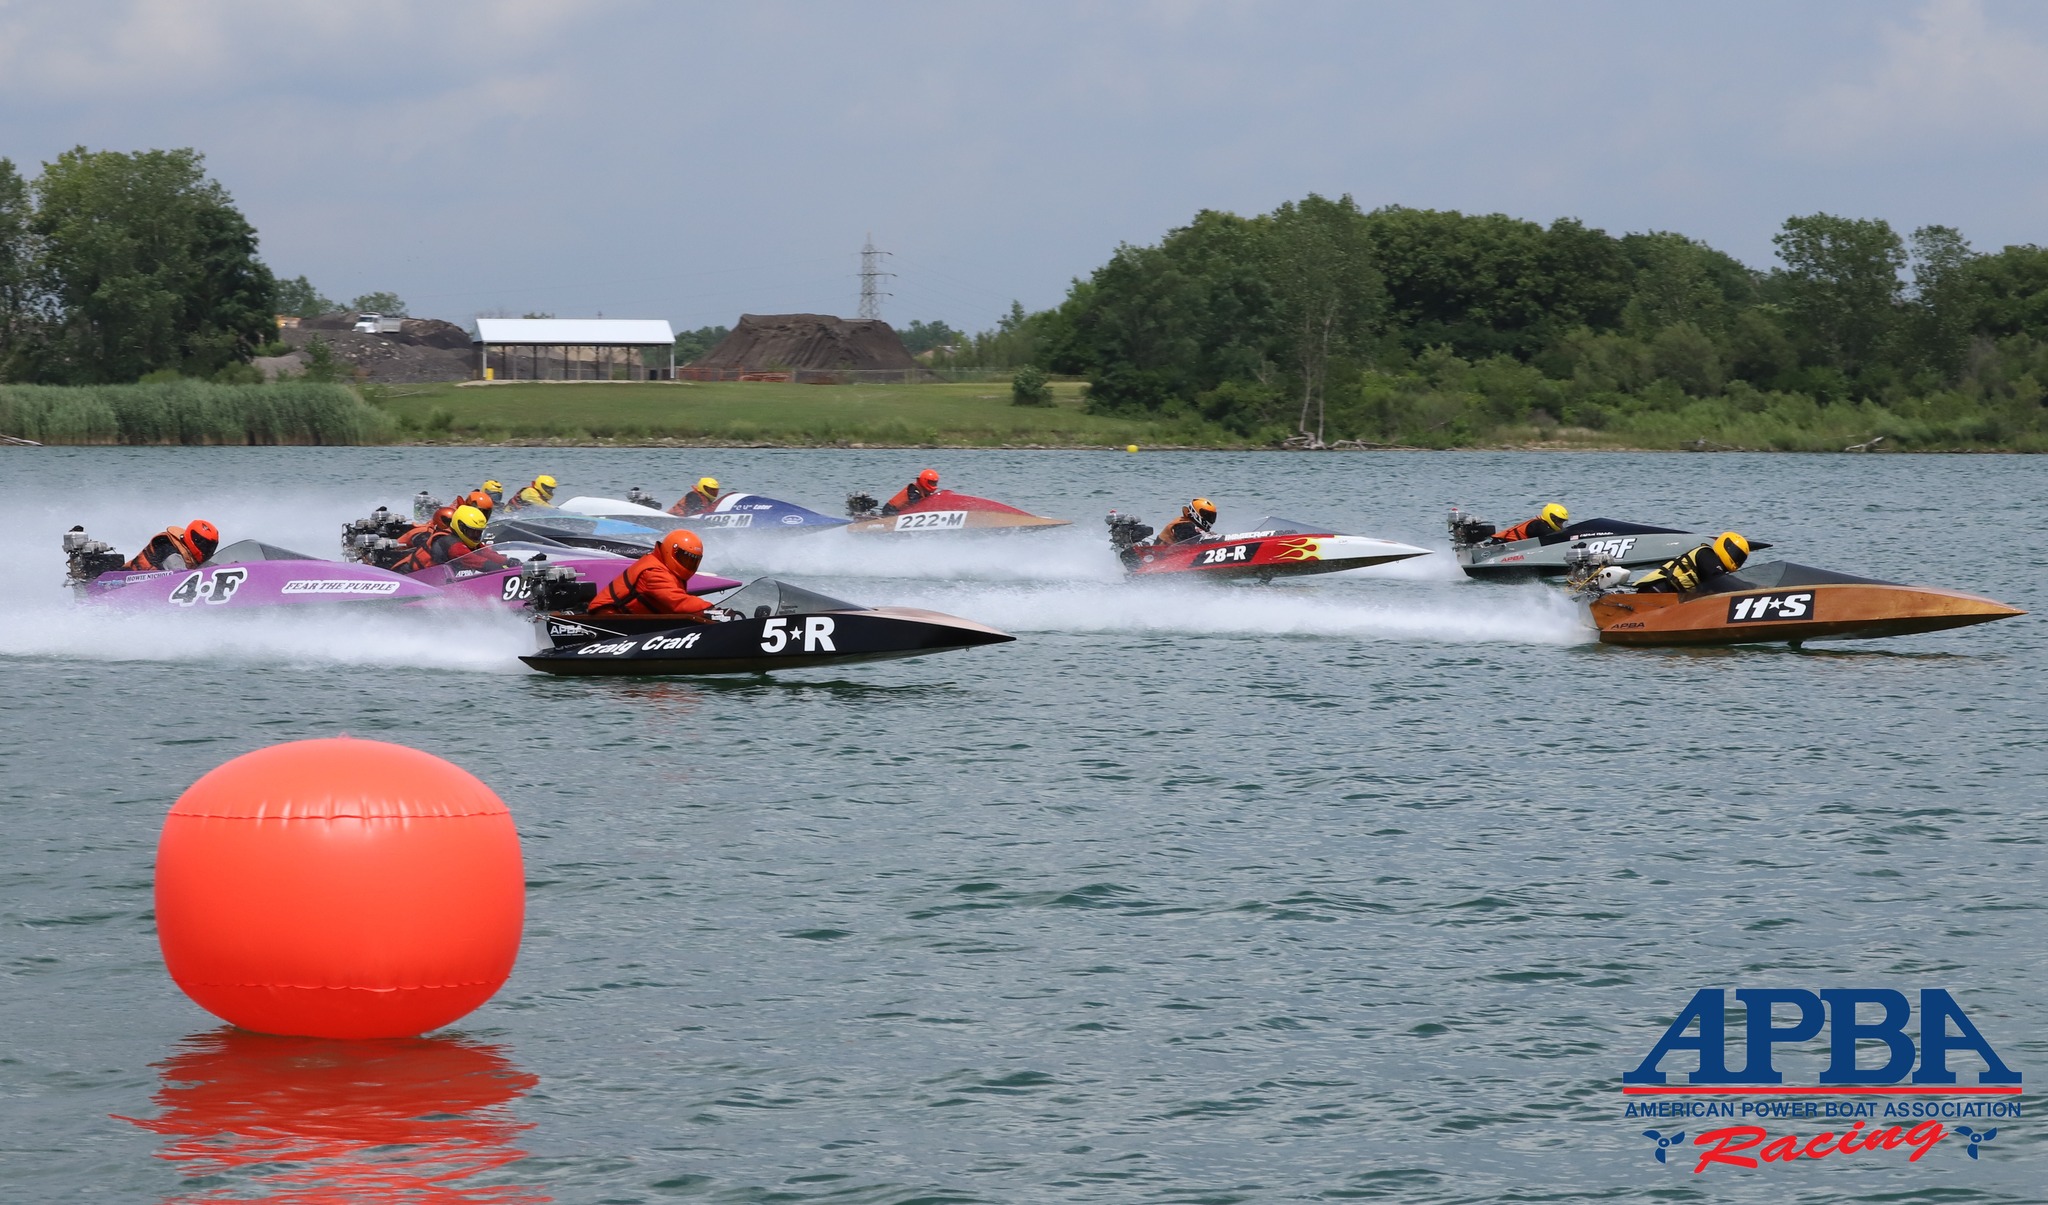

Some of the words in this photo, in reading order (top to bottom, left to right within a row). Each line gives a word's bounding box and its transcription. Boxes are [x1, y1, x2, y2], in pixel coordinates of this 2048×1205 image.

[1203, 545, 1247, 564] 28-R
[126, 574, 146, 583] HOWIE
[285, 582, 318, 591] FEAR
[319, 582, 346, 590] THE
[345, 583, 396, 591] PURPLE
[550, 625, 584, 635] APBA
[1611, 622, 1646, 630] APBA
[577, 640, 638, 655] Craig
[641, 632, 702, 651] Craft
